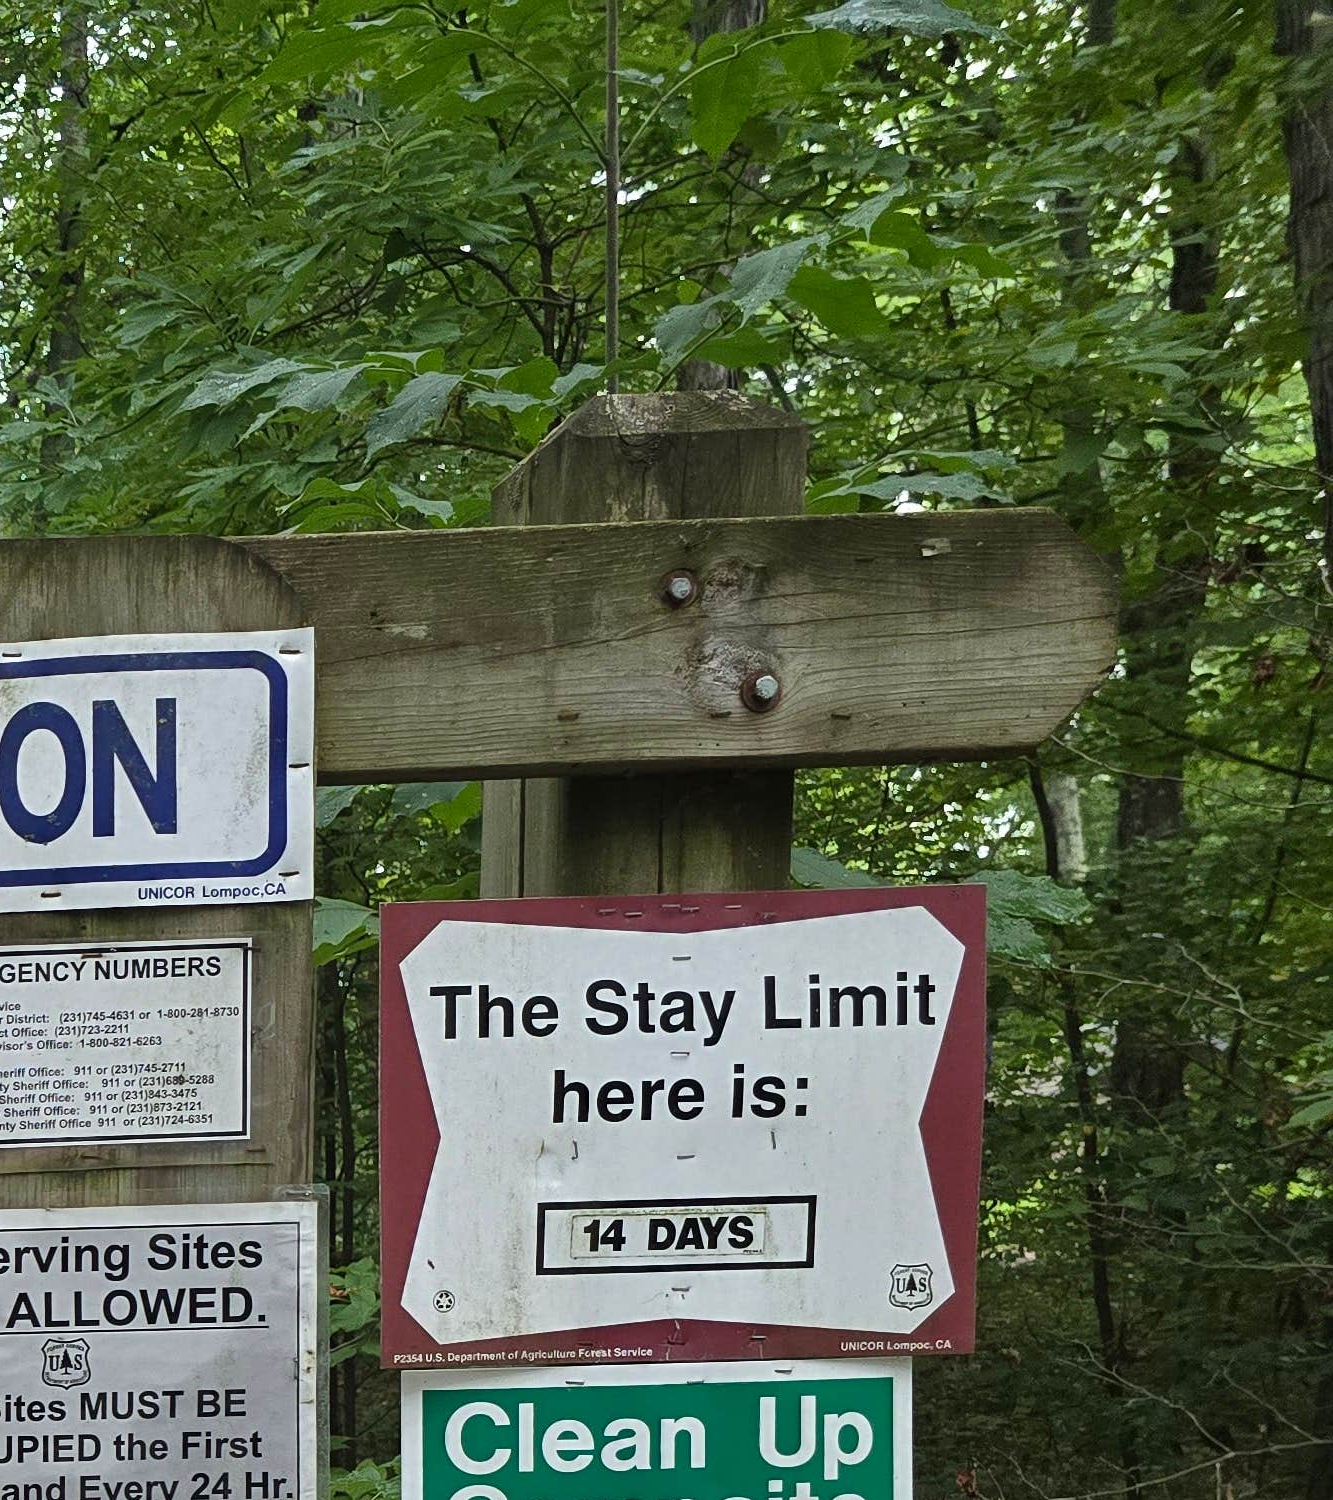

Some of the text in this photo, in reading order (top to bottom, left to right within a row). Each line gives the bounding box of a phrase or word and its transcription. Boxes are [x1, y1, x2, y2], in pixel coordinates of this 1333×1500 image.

[137, 884, 195, 902] UNICOR
[94, 957, 221, 980] NUMBERS
[6, 1014, 49, 1024] District:
[59, 1011, 135, 1023] (231)745-4631
[139, 1011, 150, 1019] or
[157, 1007, 239, 1018] 1-800-281-8730
[429, 972, 936, 1046] The Stay Limit
[28, 1067, 64, 1078] Office:
[74, 1066, 92, 1075] 911
[96, 1066, 108, 1074] or
[111, 1063, 185, 1076] (231)745-2711
[552, 1063, 809, 1123] here is:
[147, 1233, 263, 1271] Sites
[582, 1216, 754, 1252] 14 DAYS
[6, 1288, 267, 1329] ALLOWED.
[841, 1339, 951, 1353] UNICOR Lompoc, CA
[444, 1395, 873, 1480] Clean Up
